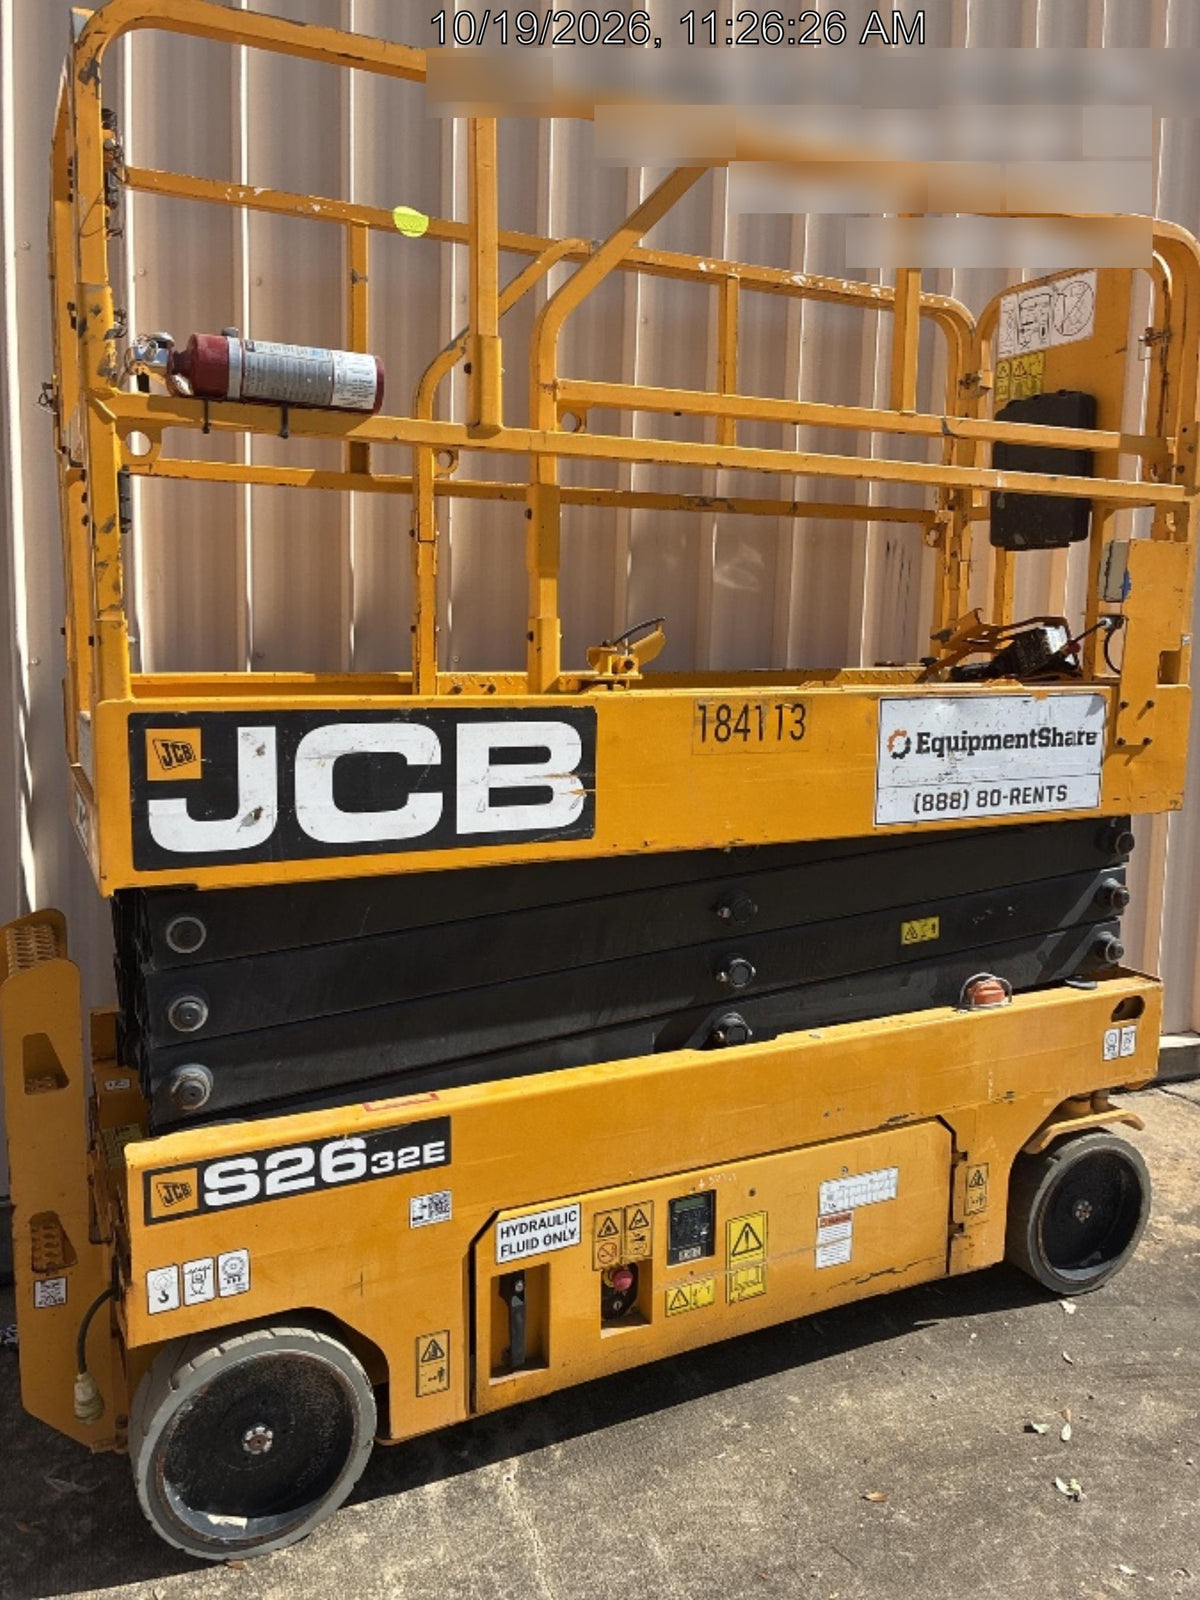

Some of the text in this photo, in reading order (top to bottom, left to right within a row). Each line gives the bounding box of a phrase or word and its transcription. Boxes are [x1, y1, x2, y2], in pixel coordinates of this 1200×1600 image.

[697, 703, 806, 743] 184113
[160, 742, 193, 767] JCB
[916, 727, 1097, 758] EquipmentShare
[148, 721, 585, 852] JCB
[914, 785, 1068, 814] (888) 80-RENTS
[163, 1183, 191, 1204] JCB
[500, 1210, 578, 1240] HYDRAULIC
[500, 1228, 577, 1258] FLUID ONLY
